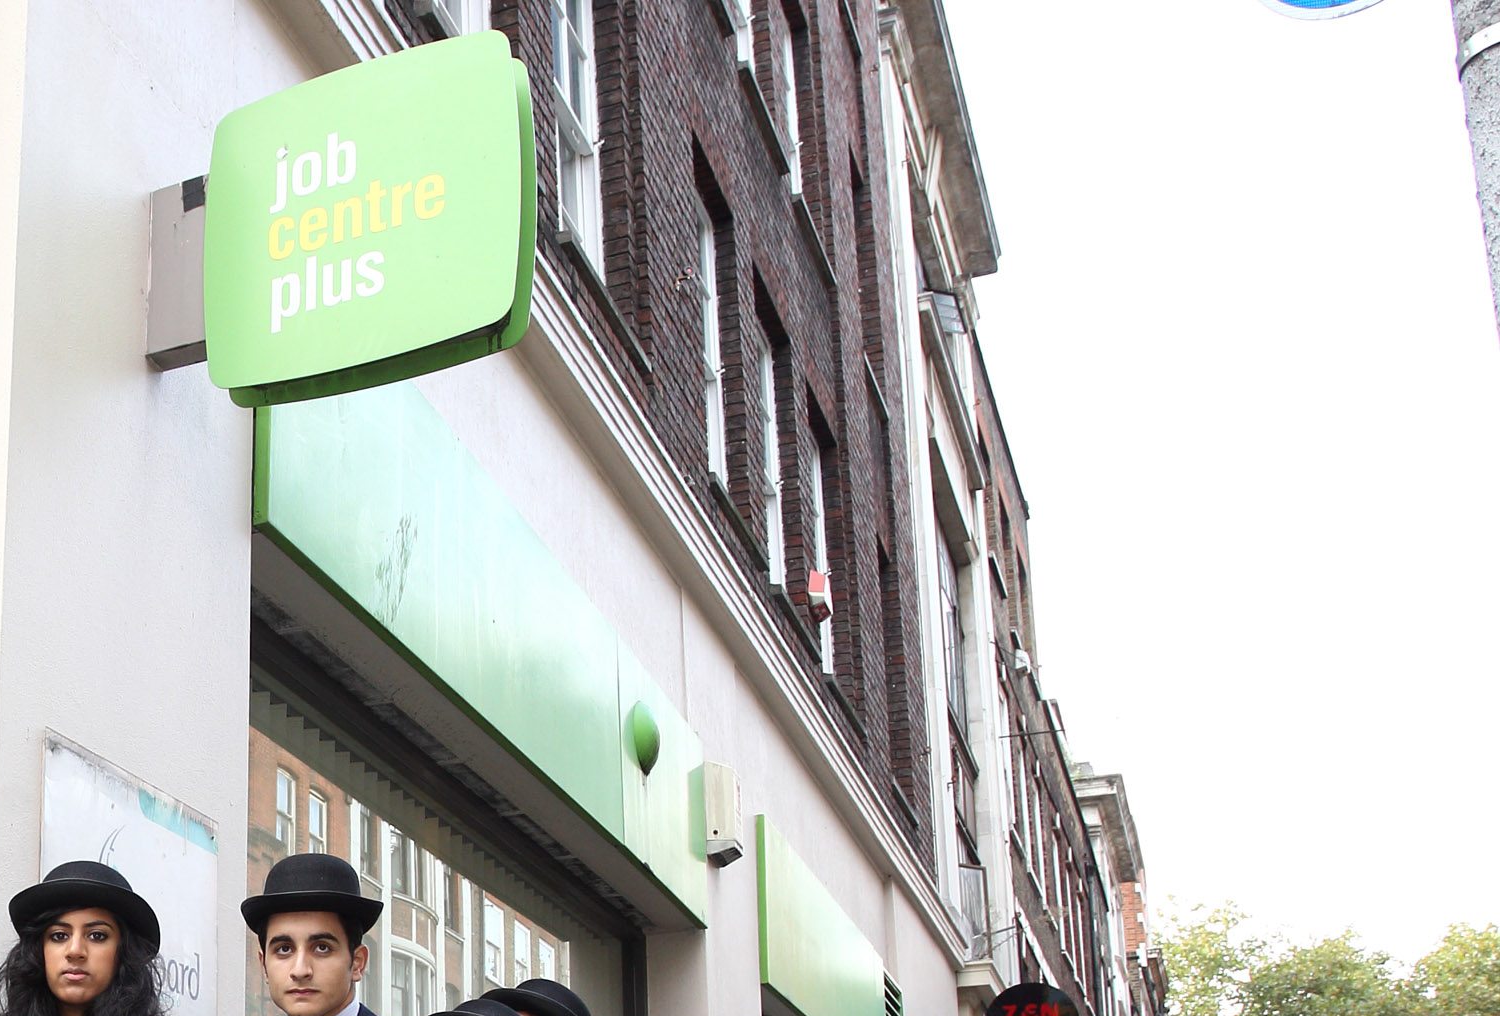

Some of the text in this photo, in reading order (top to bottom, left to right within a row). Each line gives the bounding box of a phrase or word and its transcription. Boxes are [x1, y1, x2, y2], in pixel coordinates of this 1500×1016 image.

[269, 132, 357, 214] job
[268, 172, 446, 260] centre
[270, 251, 385, 334] plus
